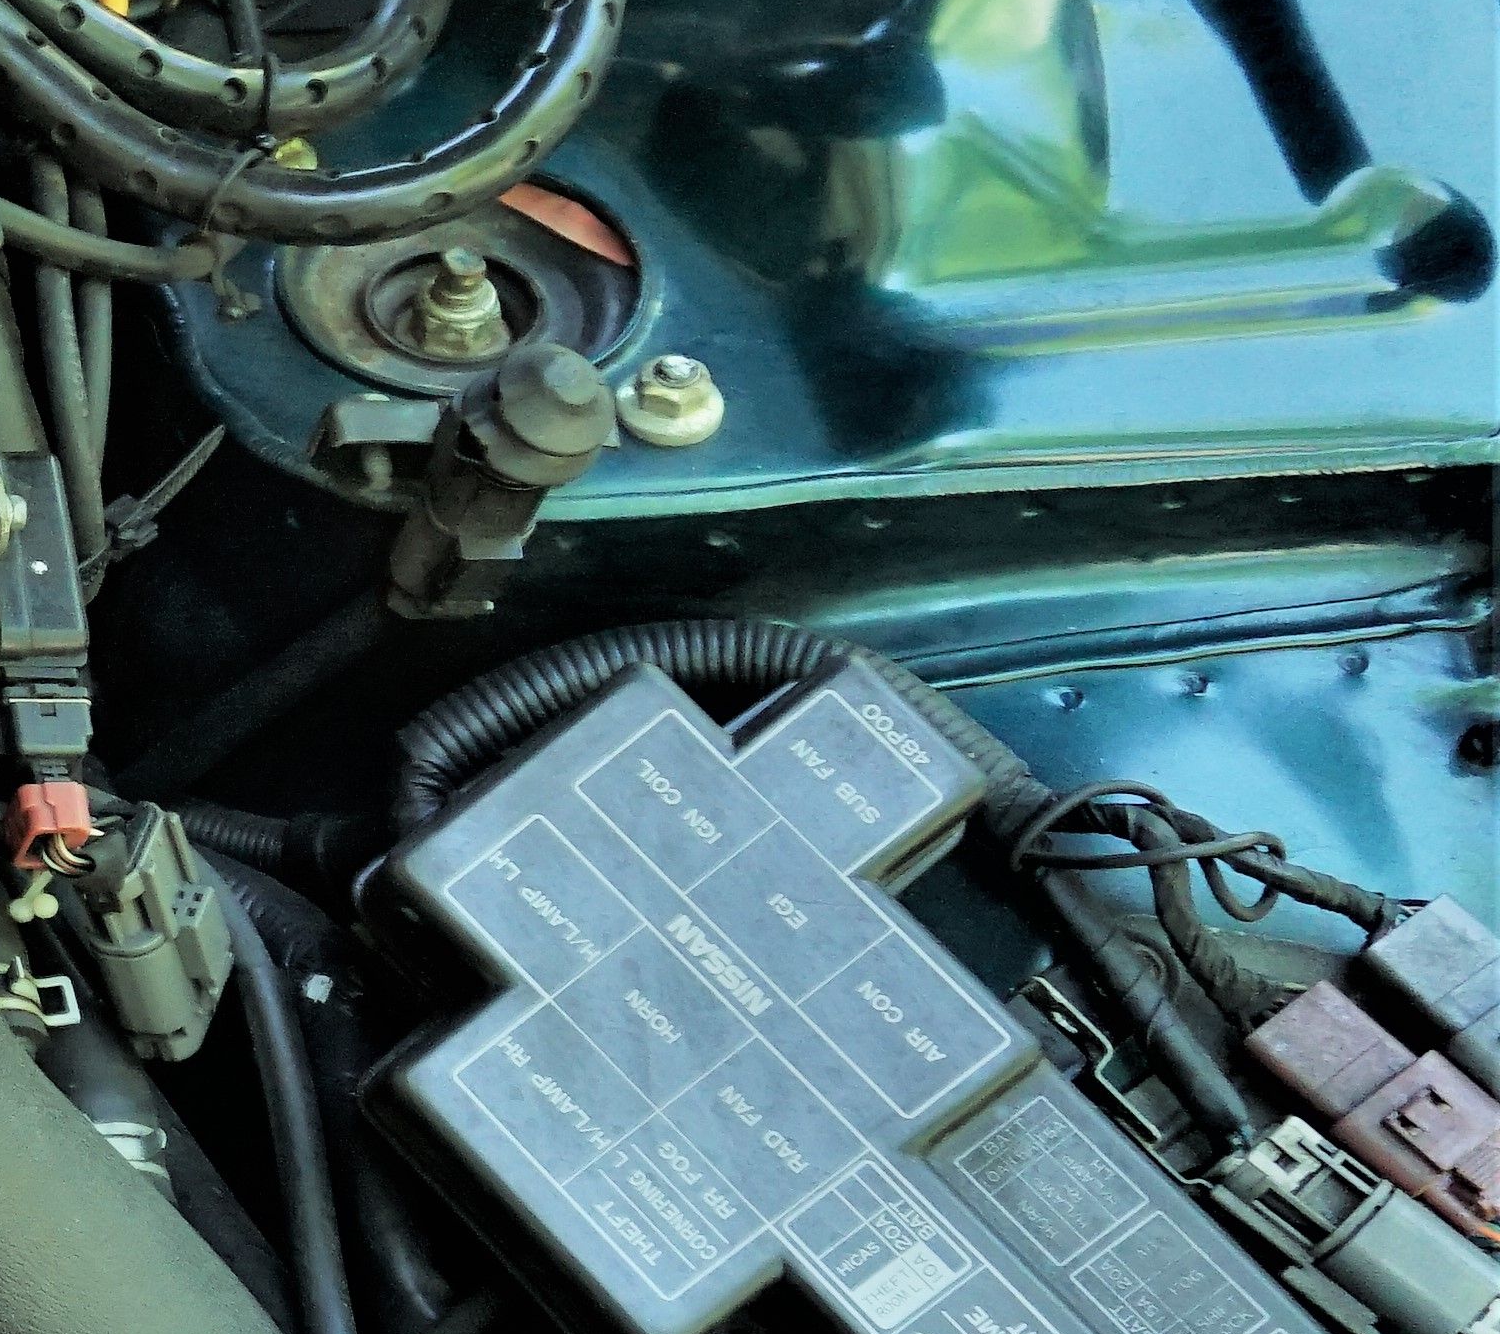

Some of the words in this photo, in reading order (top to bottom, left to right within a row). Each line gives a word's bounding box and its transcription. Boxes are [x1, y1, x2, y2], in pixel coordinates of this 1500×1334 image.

[858, 699, 933, 770] 48P00
[788, 737, 836, 781] FAN
[632, 757, 685, 807] COIL
[832, 779, 883, 826] SUB
[681, 806, 723, 845] IGN
[486, 850, 521, 881] LH
[519, 882, 602, 962] H/LAMP
[767, 891, 808, 929] EGI
[664, 912, 774, 1016] NISSAN
[622, 987, 683, 1043] HORN
[856, 979, 906, 1025] CON
[496, 1033, 533, 1067] RH
[903, 1026, 947, 1066] AIR
[529, 1070, 614, 1150] H/LAMP
[716, 1083, 763, 1126] FAN
[608, 1149, 629, 1168] L
[655, 1139, 703, 1184] FOG
[761, 1127, 810, 1174] RAD
[626, 1170, 720, 1259] CORNERING
[701, 1187, 737, 1220] RR
[887, 1194, 937, 1241] BATT
[593, 1195, 666, 1264] THEFT
[871, 1212, 913, 1251] 20A
[834, 1238, 881, 1278] HICAS
